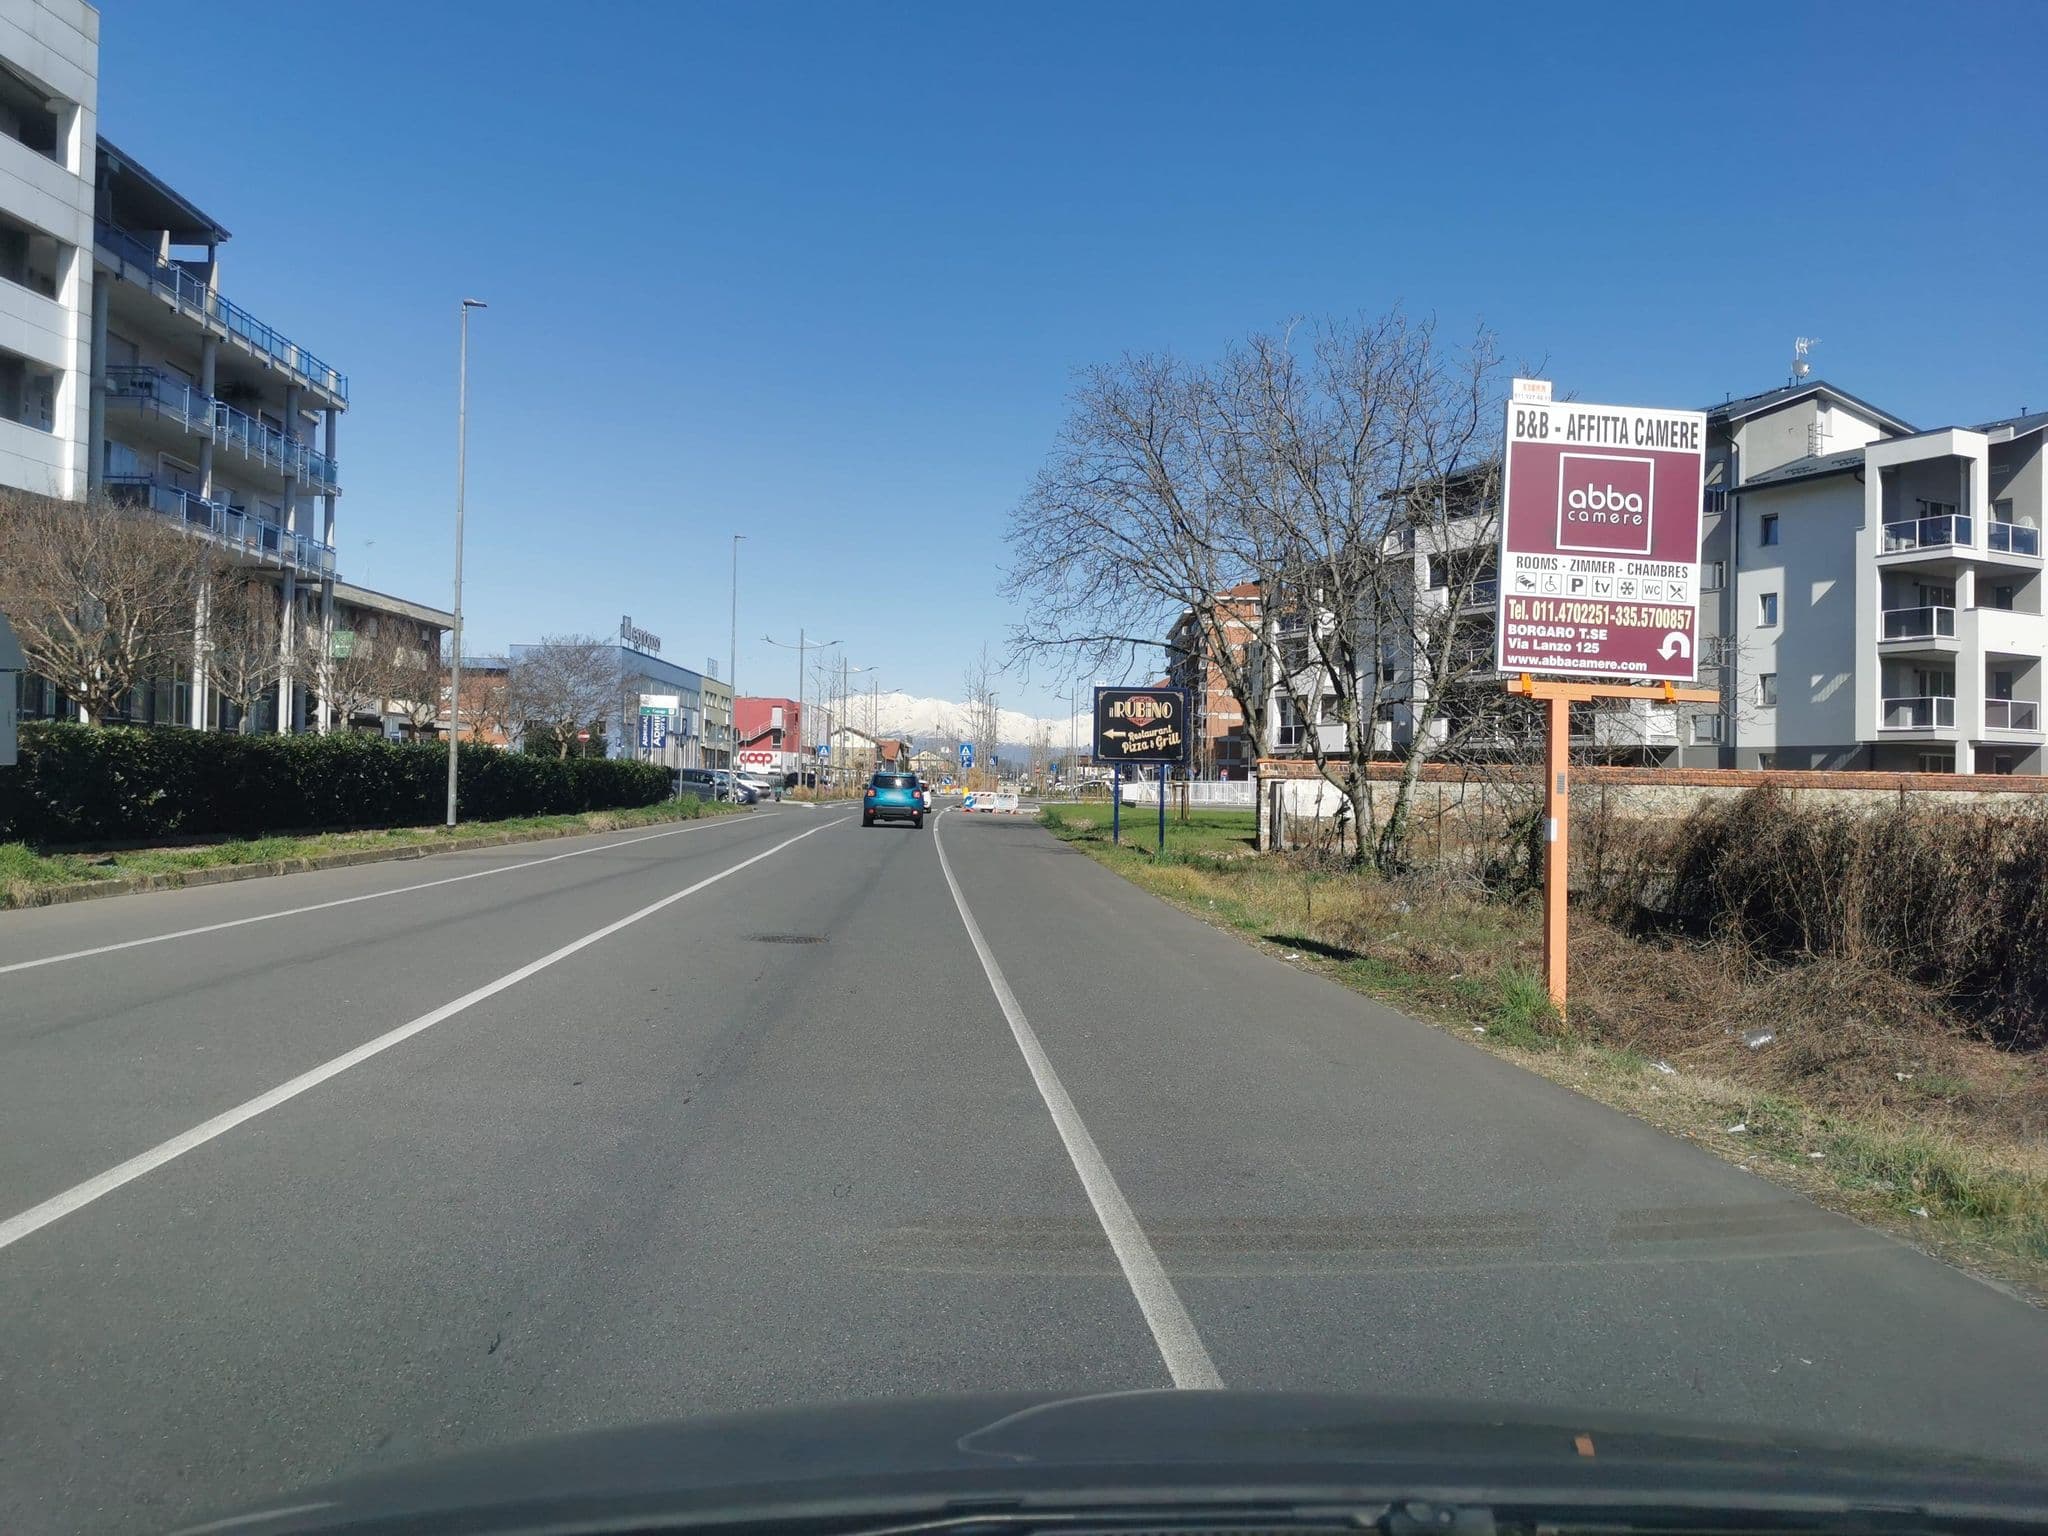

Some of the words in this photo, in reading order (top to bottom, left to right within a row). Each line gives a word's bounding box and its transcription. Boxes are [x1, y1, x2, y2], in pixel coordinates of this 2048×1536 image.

[1516, 410, 1549, 439] B&B
[1566, 413, 1629, 445] AFFITTA
[1635, 417, 1699, 450] CAMERE
[1568, 483, 1643, 513] abba
[1568, 510, 1643, 525] camere
[1516, 556, 1558, 571] ROOMS
[1570, 559, 1615, 574] ZIMMER
[1627, 562, 1688, 579] CHAMBRES
[1571, 578, 1583, 593] P
[1595, 579, 1610, 594] tv
[1644, 584, 1661, 595] WC
[1508, 599, 1529, 620] Tel.
[1507, 623, 1575, 639] BORGARO
[1579, 628, 1608, 640] T.SE
[1507, 637, 1529, 650] Via
[1533, 639, 1572, 652] Lanzo
[1576, 641, 1600, 654] 125
[1507, 655, 1648, 671] www.abbacamere.com
[1121, 741, 1150, 754] Pizza
[1155, 732, 1181, 750] Grill
